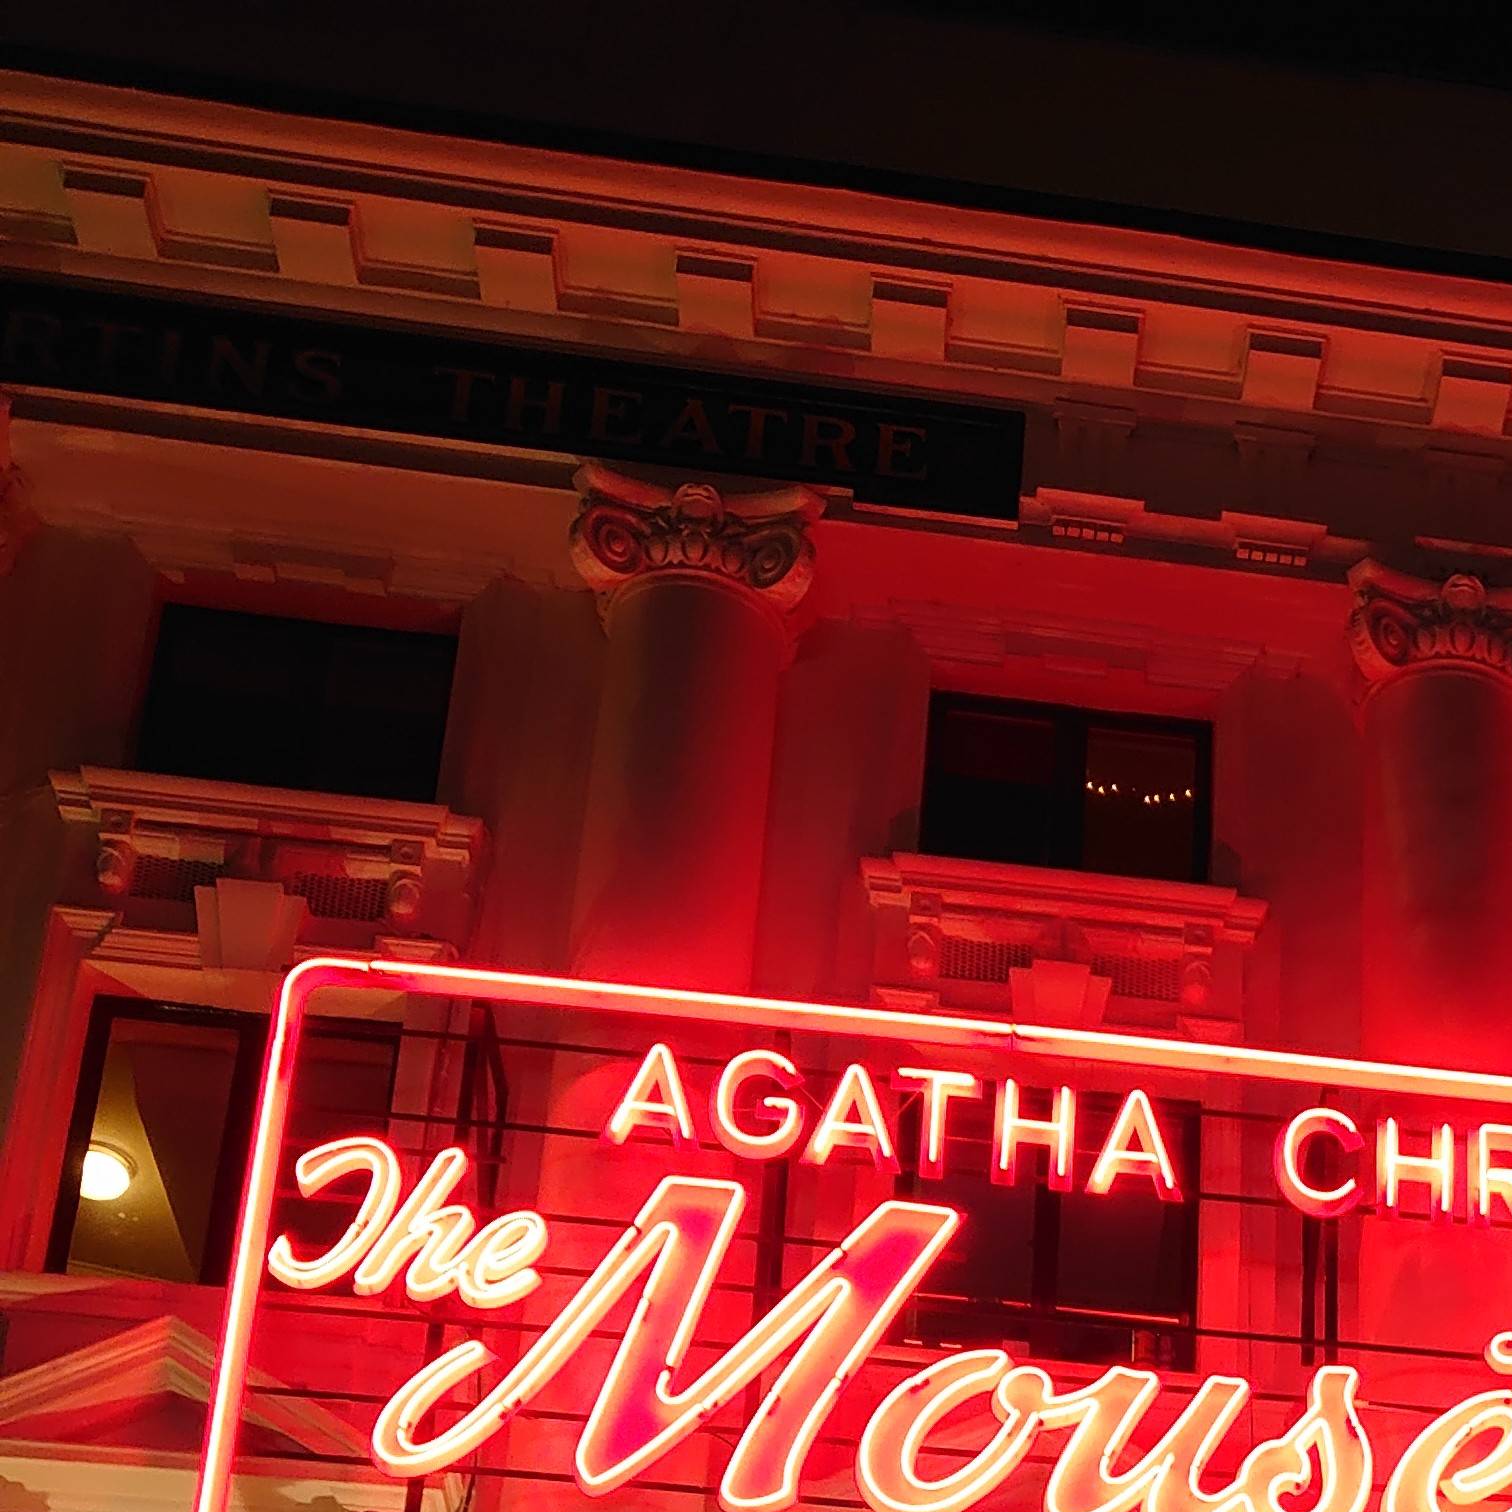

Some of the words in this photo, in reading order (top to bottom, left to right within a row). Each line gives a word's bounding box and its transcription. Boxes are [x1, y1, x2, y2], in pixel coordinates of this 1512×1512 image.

[433, 364, 931, 482] THEATRE
[604, 1042, 1183, 1201] AGATHA
[268, 1137, 549, 1307] The
